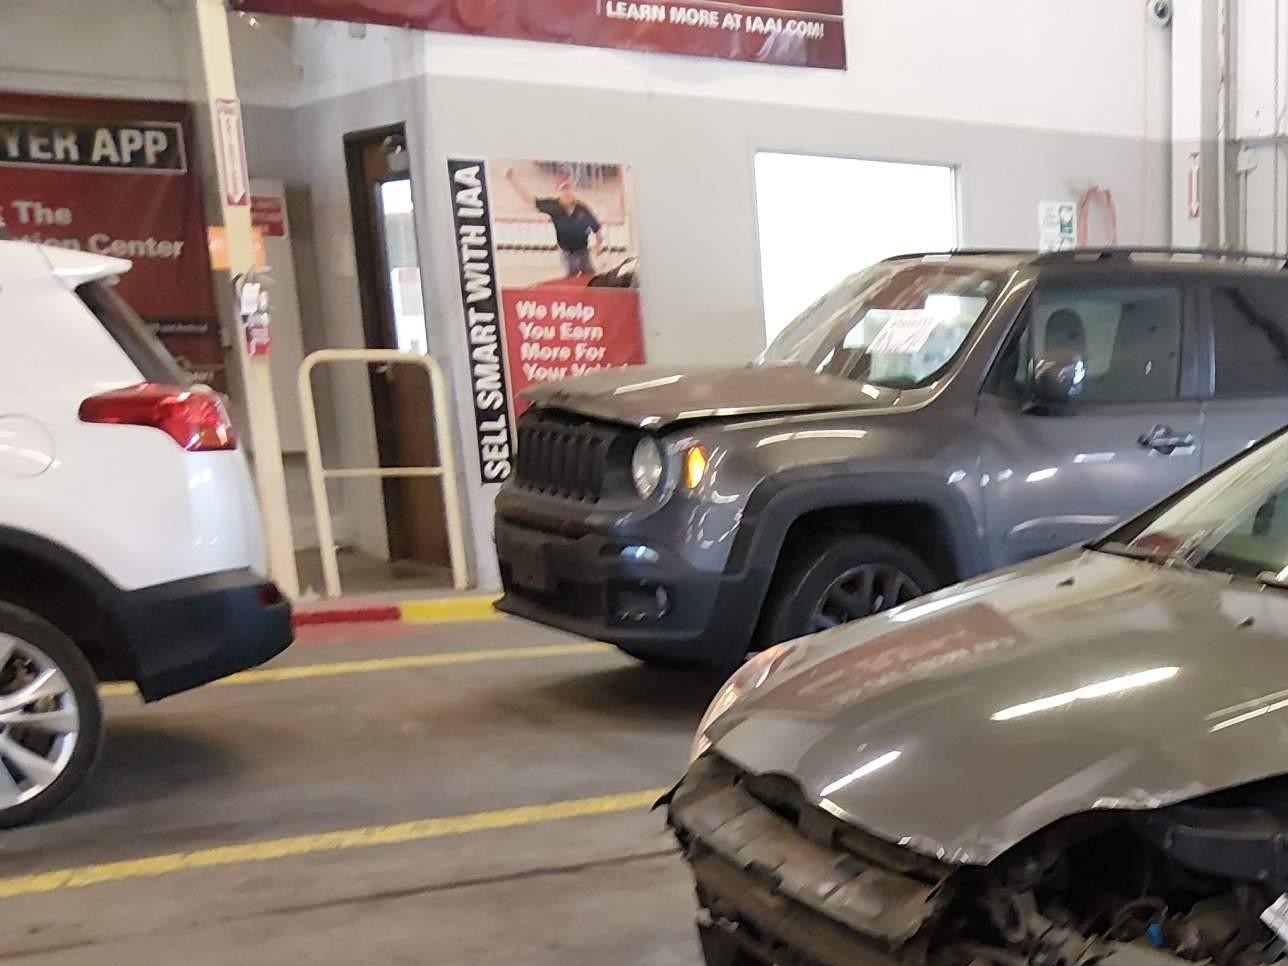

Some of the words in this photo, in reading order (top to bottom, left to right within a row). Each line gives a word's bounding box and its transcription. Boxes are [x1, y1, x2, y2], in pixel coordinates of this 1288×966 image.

[605, 0, 667, 22] LEARN
[669, 6, 720, 29] MORE
[721, 12, 743, 31] AT
[90, 127, 168, 165] APP
[454, 165, 485, 219] IAA
[10, 199, 73, 226] The
[87, 233, 185, 260] Center
[459, 225, 493, 304] WITH
[515, 300, 547, 320] We
[551, 301, 595, 323] Help
[517, 321, 556, 341] You
[559, 322, 604, 342] Earn
[467, 306, 504, 411] SMART
[520, 342, 571, 361] More
[574, 343, 607, 362] For
[521, 362, 568, 382] Your
[479, 413, 513, 480] SELL
